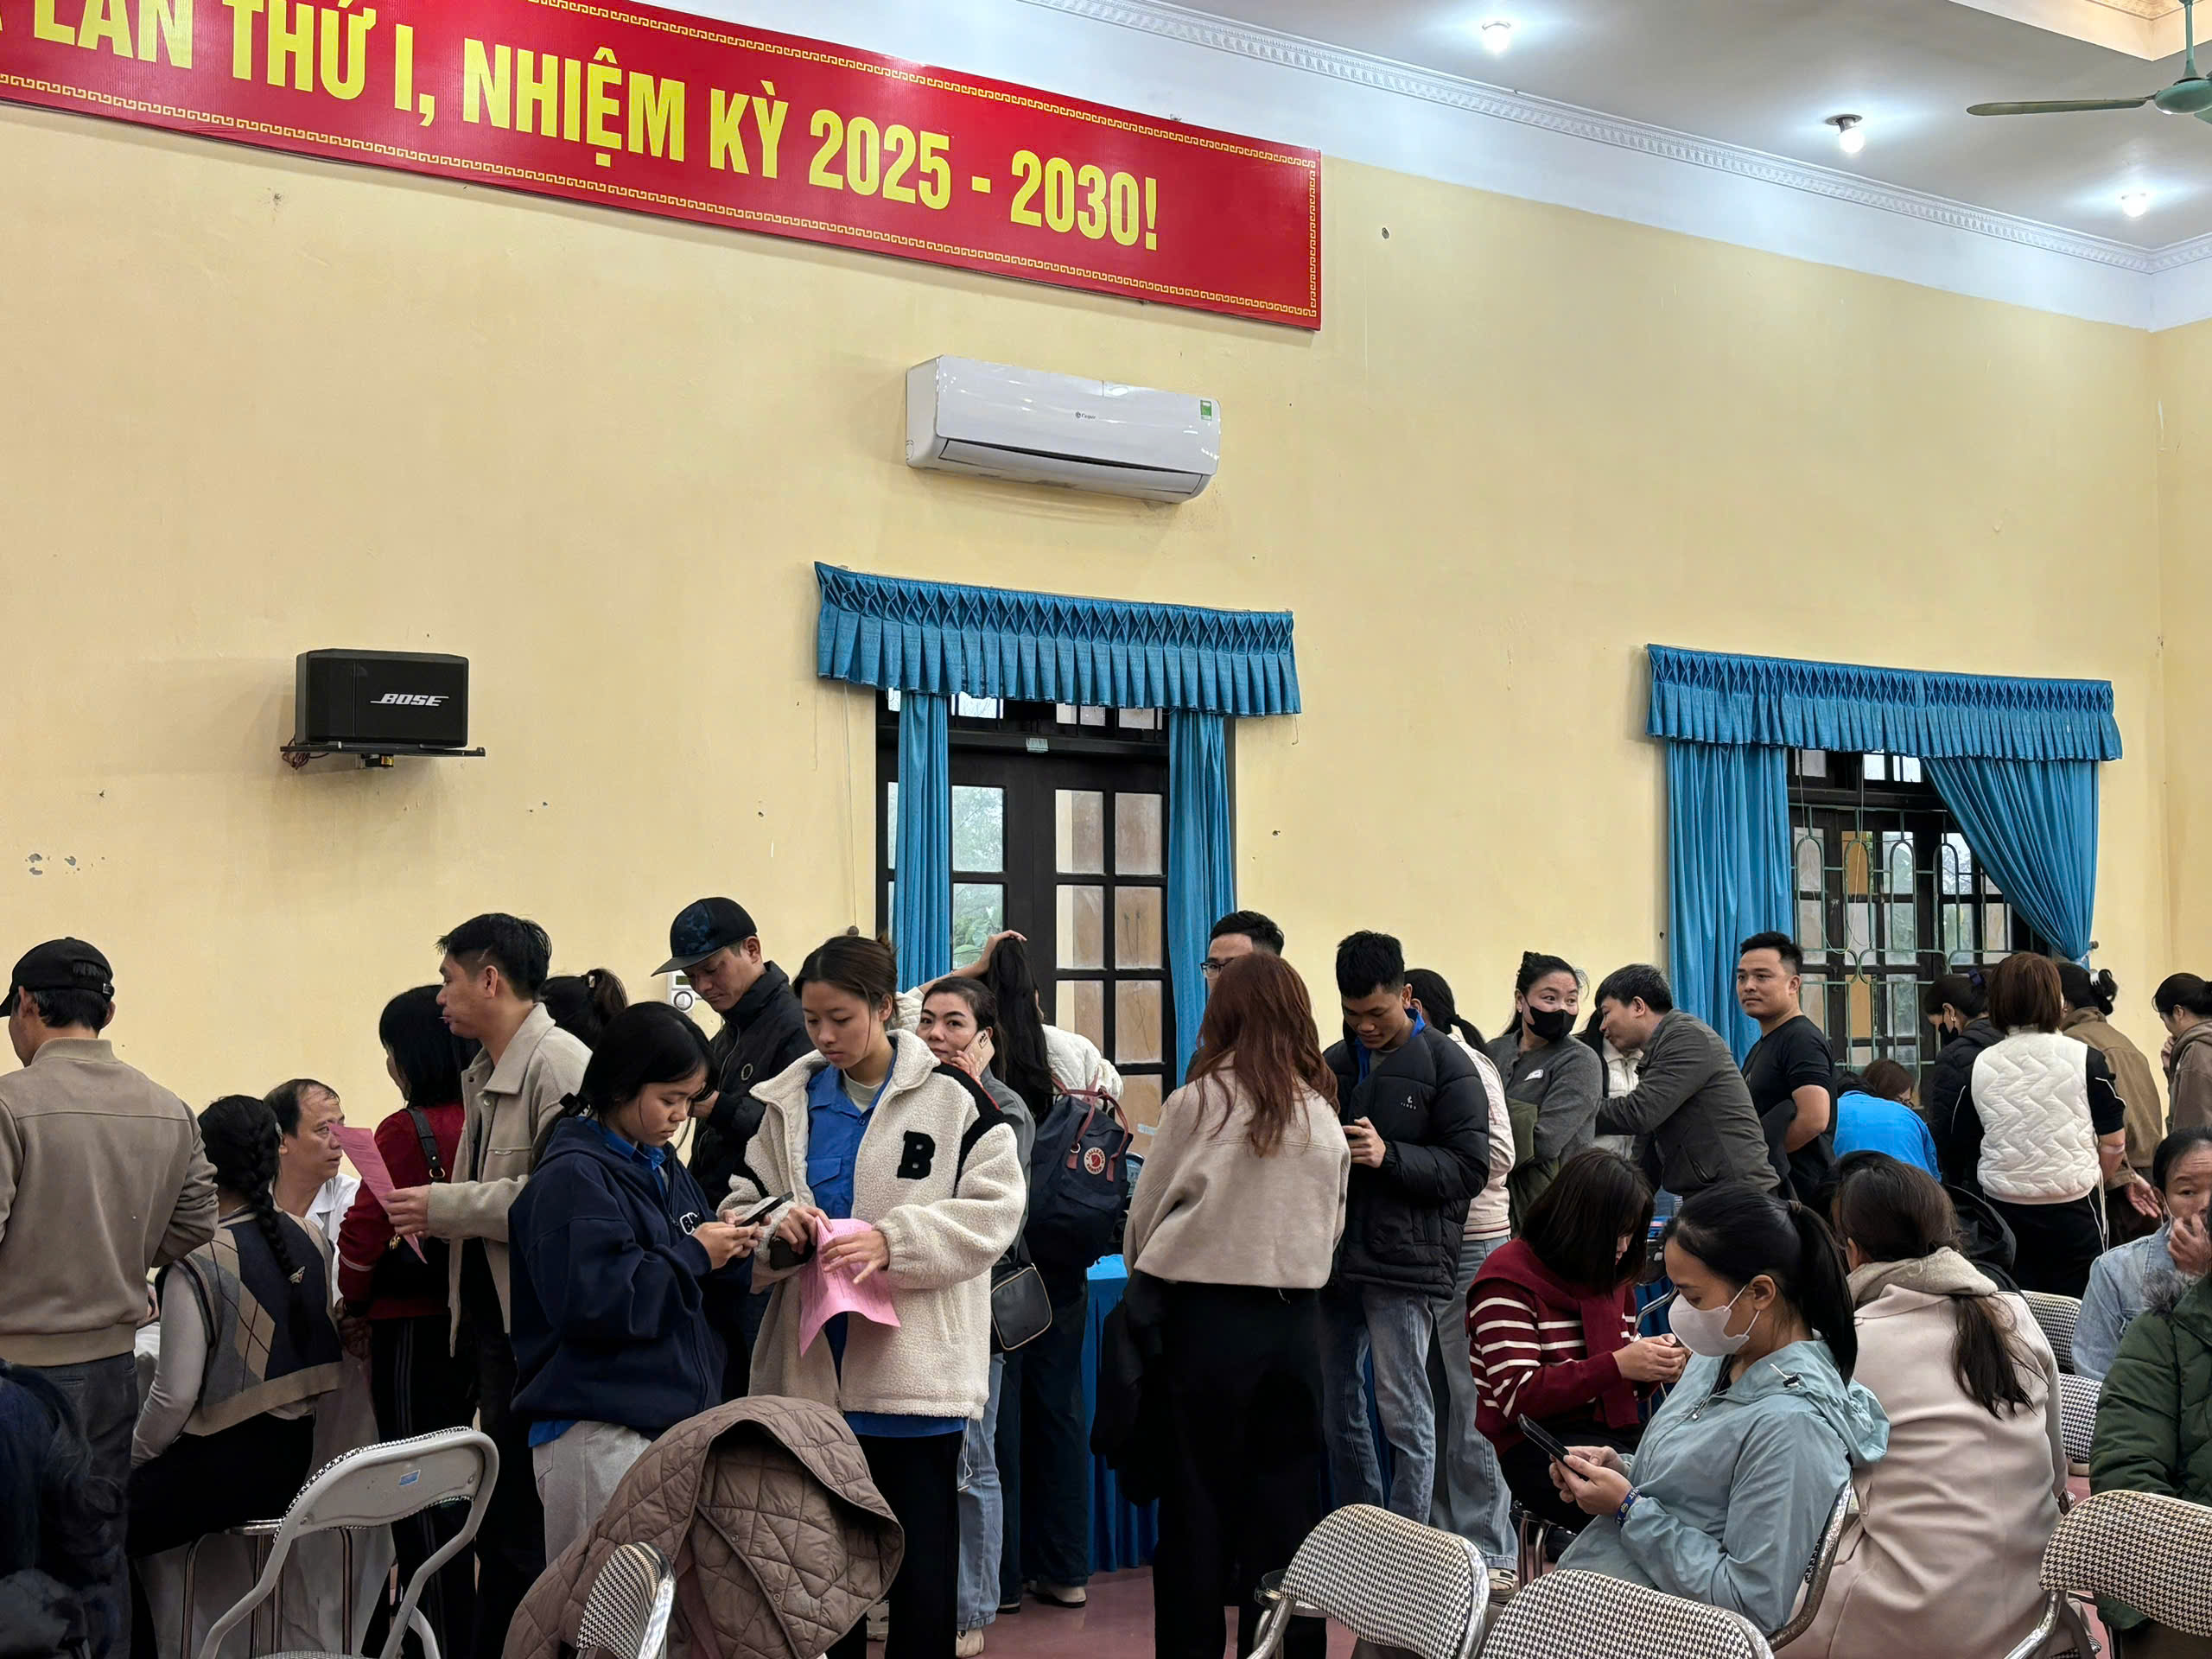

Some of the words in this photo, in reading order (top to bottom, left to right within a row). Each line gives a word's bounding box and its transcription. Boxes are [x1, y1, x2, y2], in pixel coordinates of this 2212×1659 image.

[394, 23, 435, 127] I,
[463, 37, 685, 168] NHIỆM
[709, 79, 790, 179] KỲ
[809, 110, 951, 210] 2025
[972, 177, 991, 194] -
[1011, 150, 1158, 251] 2030!
[370, 693, 449, 707] BOSE
[897, 1130, 936, 1180] B
